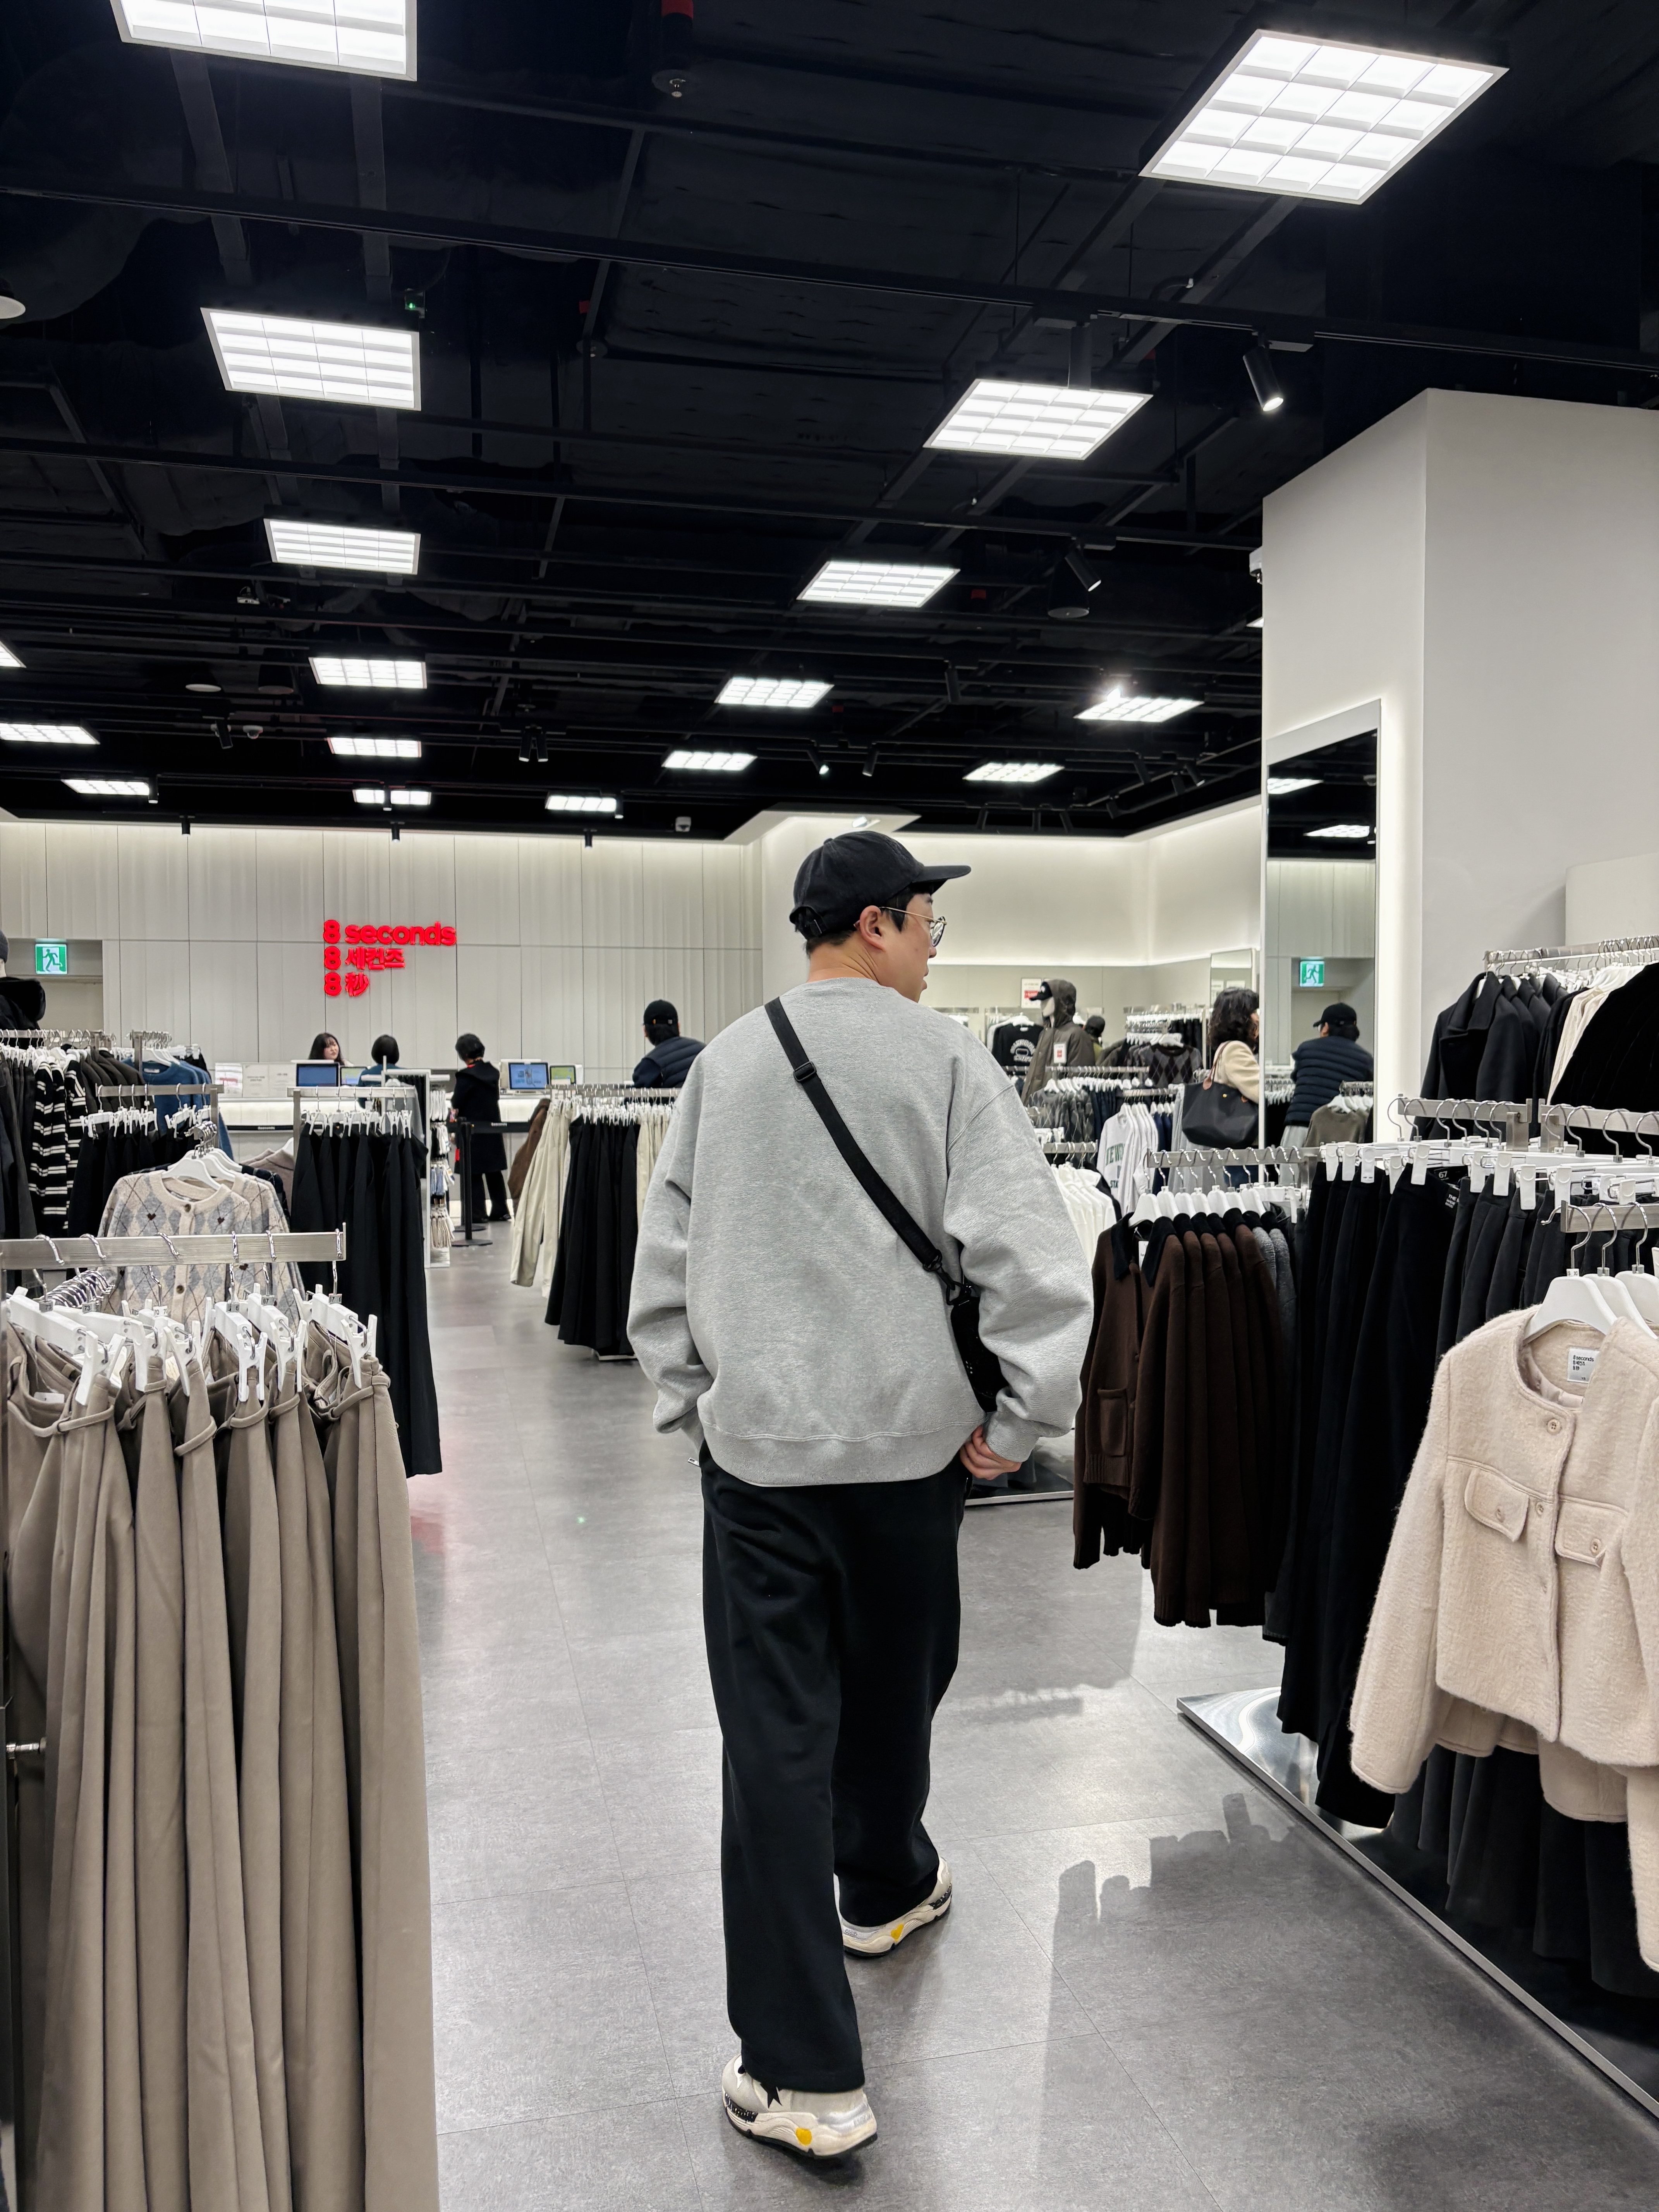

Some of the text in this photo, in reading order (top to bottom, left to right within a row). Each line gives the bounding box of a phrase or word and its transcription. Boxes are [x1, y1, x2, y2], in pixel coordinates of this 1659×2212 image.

[323, 919, 457, 946] 8 seconds
[324, 946, 406, 970] 8 세컨즈
[324, 972, 369, 997] 8 秒
